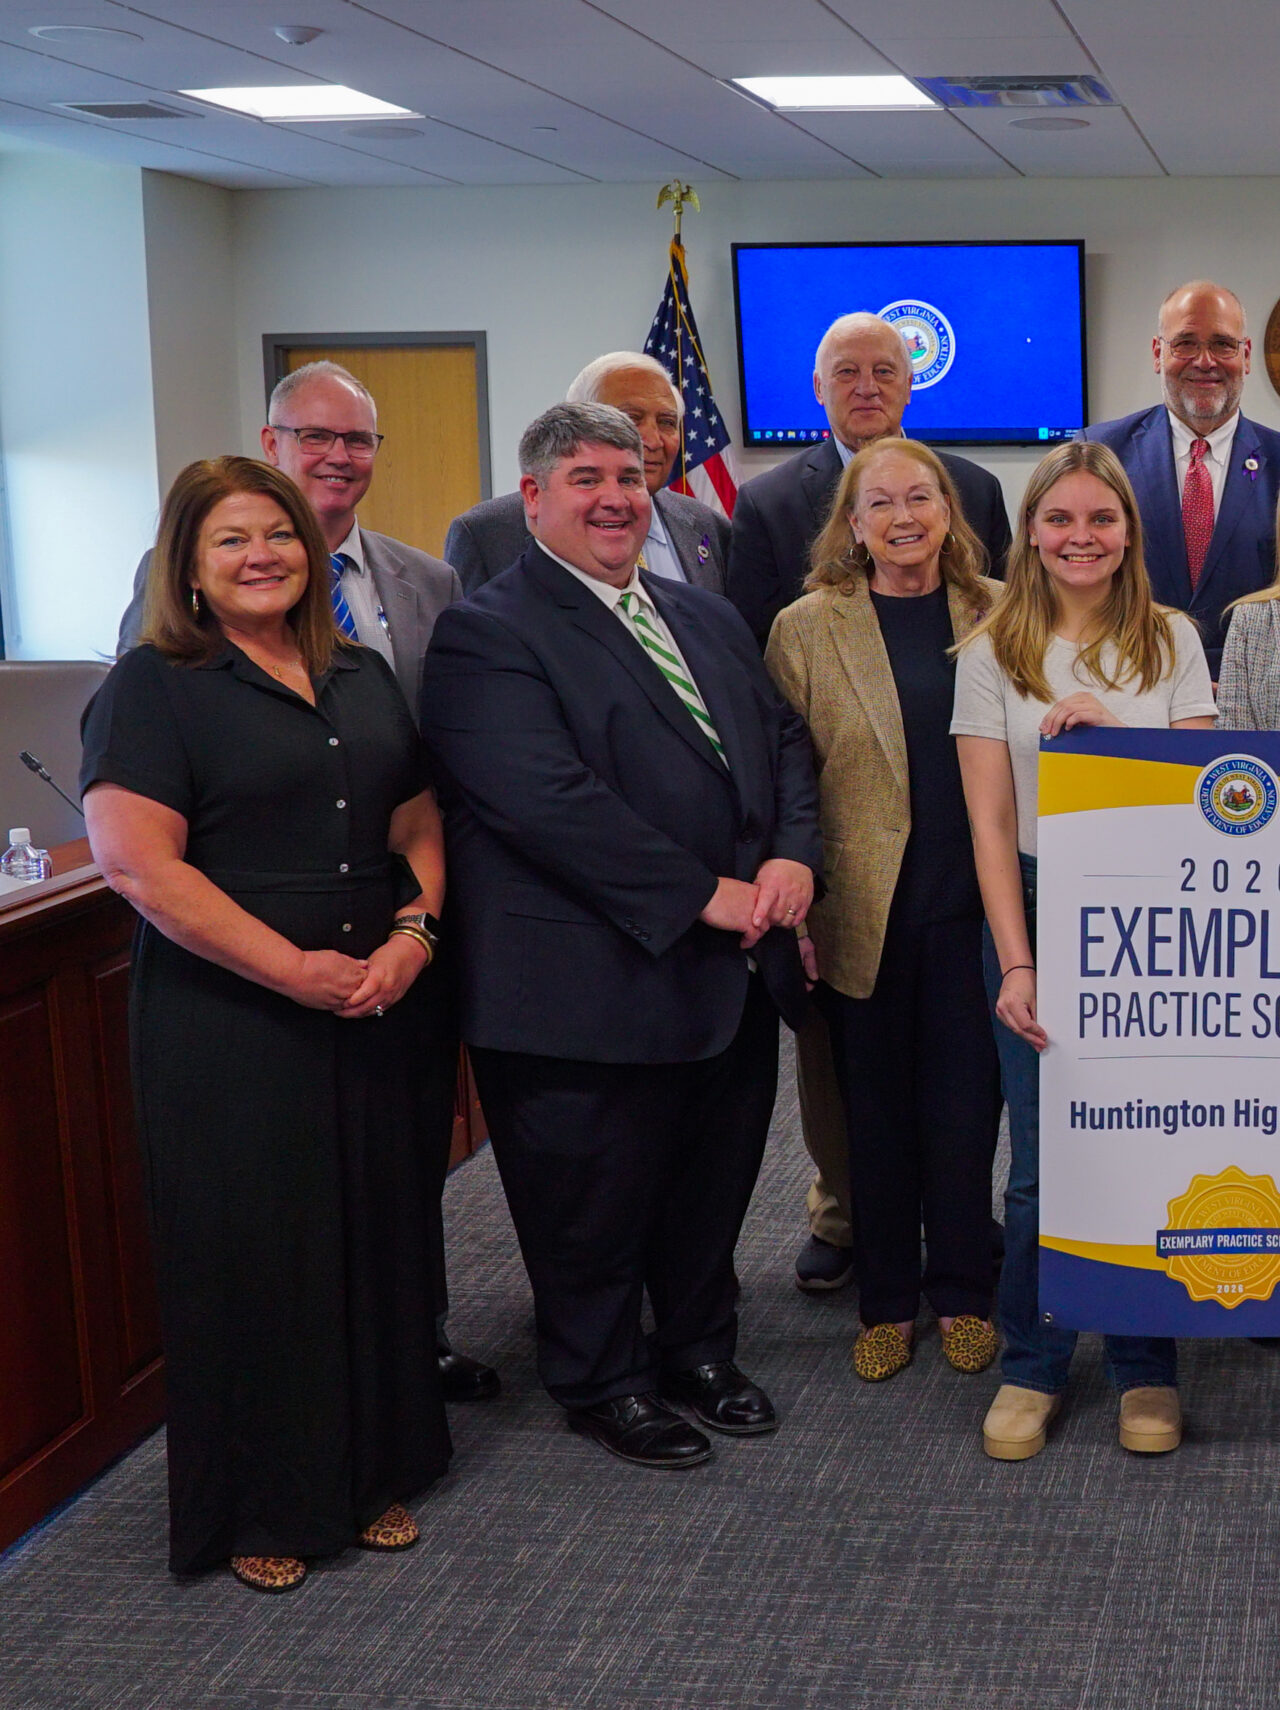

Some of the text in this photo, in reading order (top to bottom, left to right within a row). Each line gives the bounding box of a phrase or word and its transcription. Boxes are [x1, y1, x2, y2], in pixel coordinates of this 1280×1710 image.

[884, 306, 939, 327] EST VIRGINIA
[1208, 761, 1268, 782] WEST VIRGINIA
[1201, 787, 1276, 834] DEPARTMENT OF EDUCATION
[1079, 991, 1242, 1039] PRACTICE
[1070, 1099, 1225, 1135] Huntington
[1160, 1235, 1214, 1249] EXEMPLARY
[1217, 1234, 1263, 1248] PRACTICE
[1217, 1284, 1244, 1294] 2026
